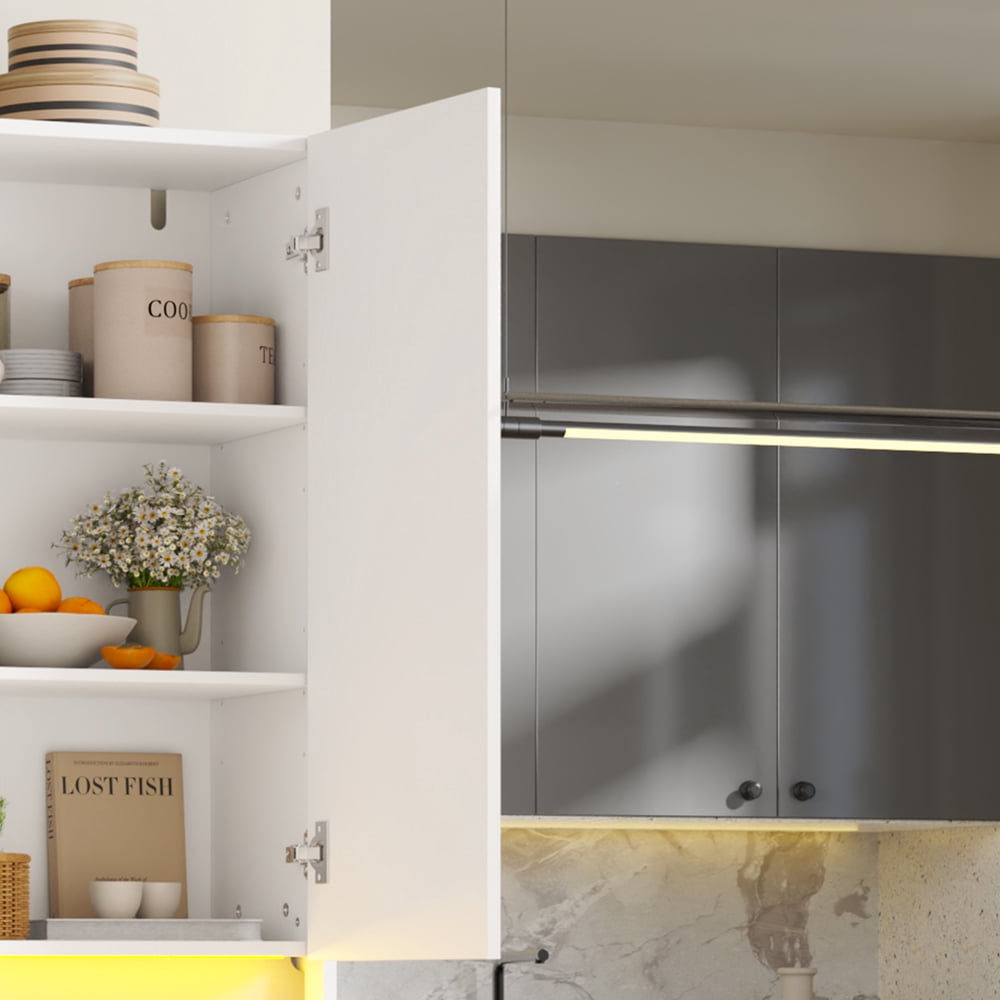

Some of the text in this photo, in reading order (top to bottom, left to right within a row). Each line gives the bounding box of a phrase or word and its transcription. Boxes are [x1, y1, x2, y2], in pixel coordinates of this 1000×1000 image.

[148, 299, 191, 321] COO
[259, 345, 275, 365] TE
[61, 776, 173, 796] LOST FISH
